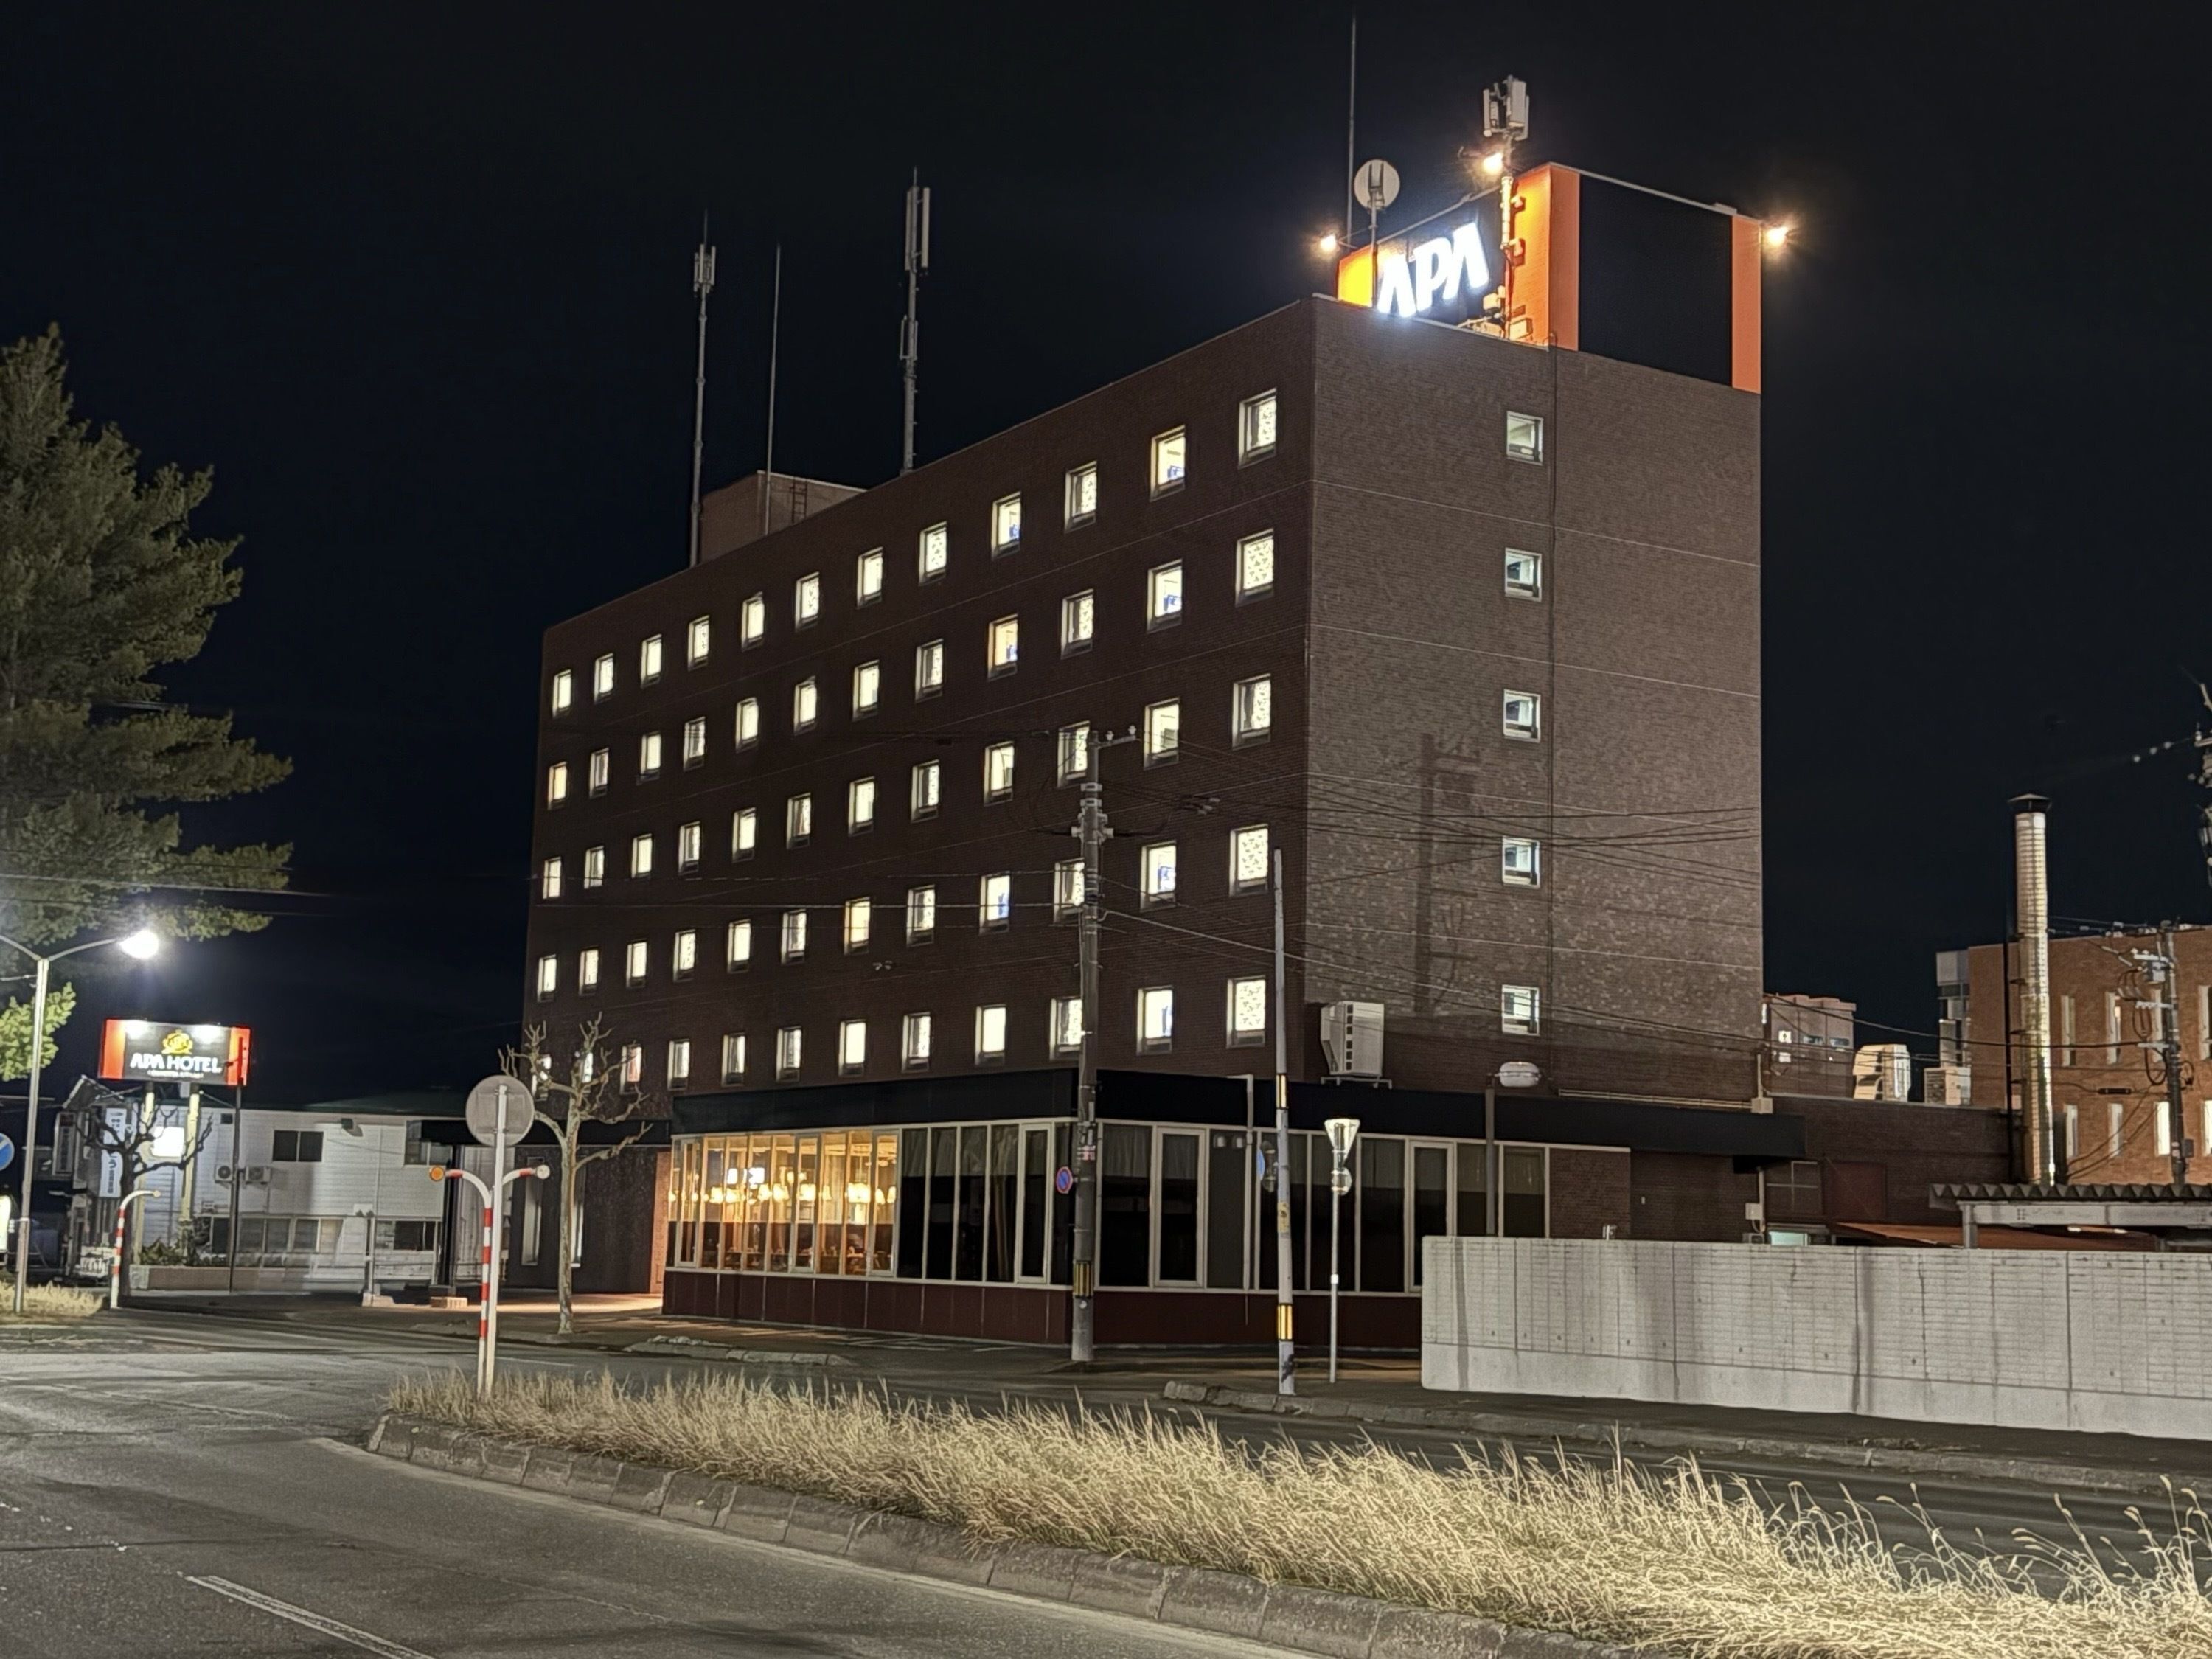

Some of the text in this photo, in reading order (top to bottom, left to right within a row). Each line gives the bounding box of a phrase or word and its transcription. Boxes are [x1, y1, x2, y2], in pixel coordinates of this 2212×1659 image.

[1377, 221, 1489, 318] APA
[130, 1052, 223, 1073] APA HOTEL
